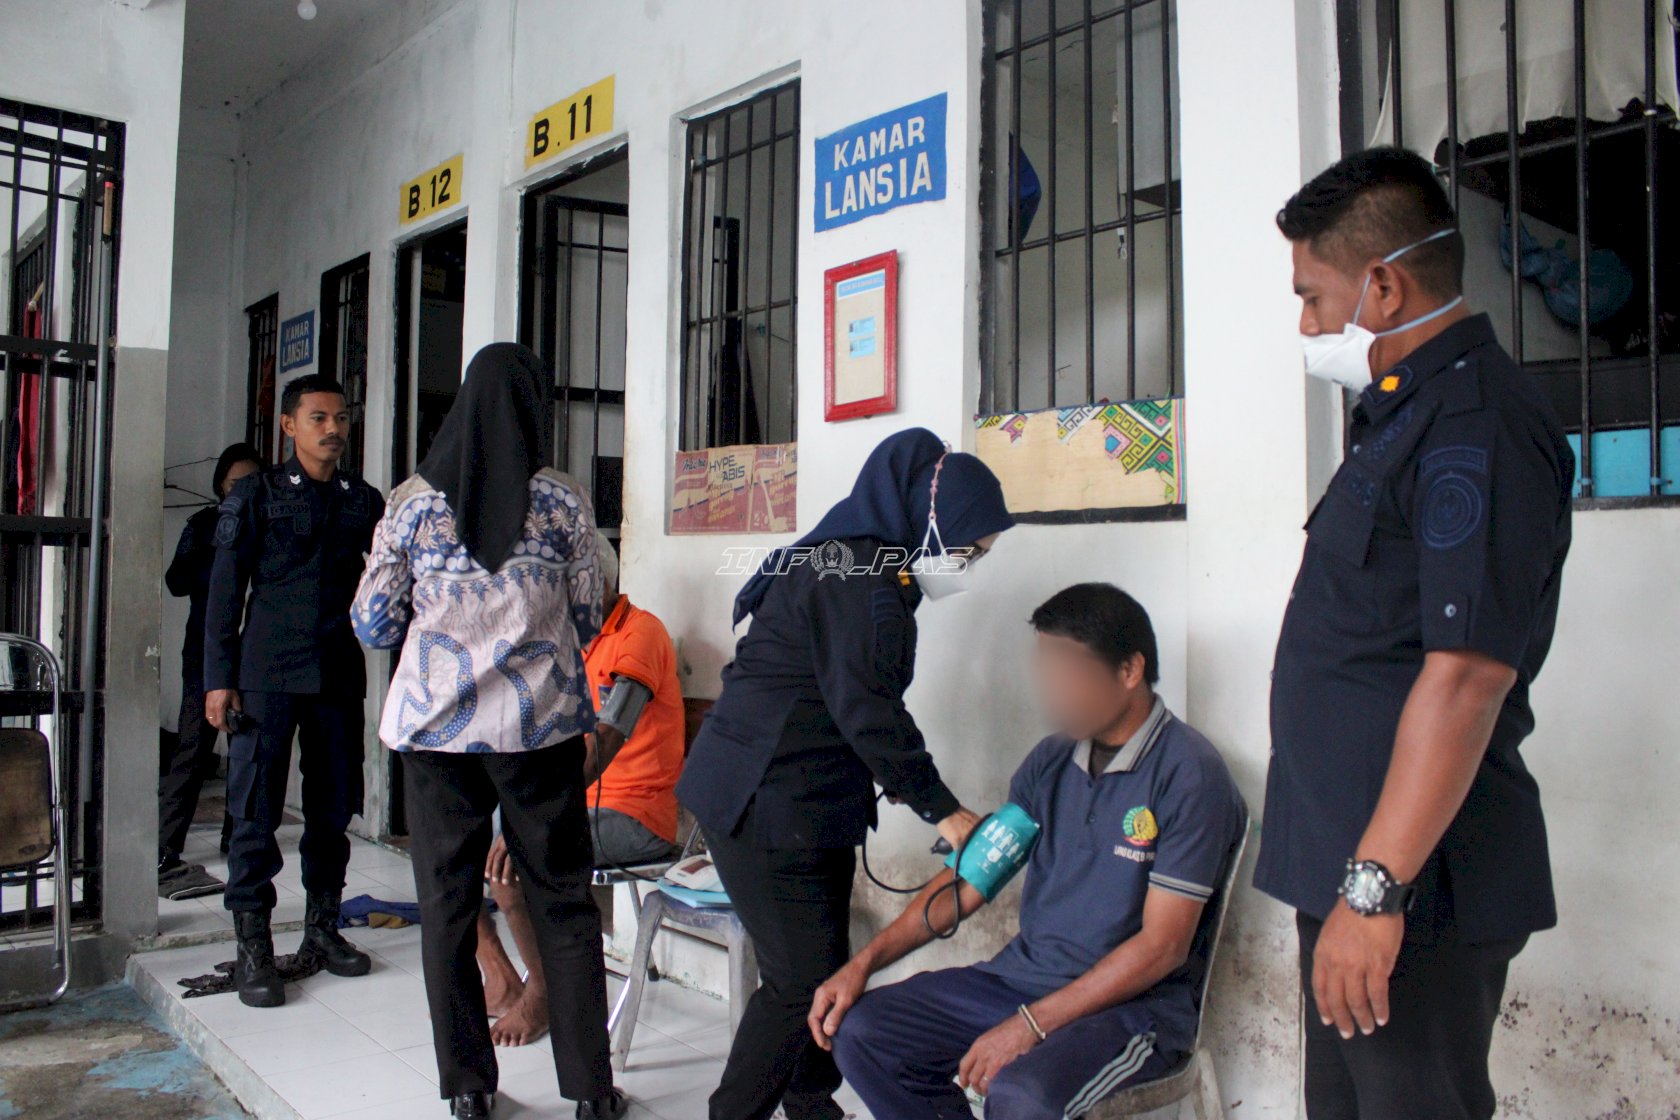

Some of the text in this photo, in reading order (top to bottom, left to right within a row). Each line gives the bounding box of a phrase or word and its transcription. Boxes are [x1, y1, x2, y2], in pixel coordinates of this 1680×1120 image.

[834, 115, 925, 171] KAMAR
[824, 151, 932, 220] LANSIA
[285, 320, 309, 342] KAMAR
[282, 338, 310, 367] LANSIA
[709, 454, 737, 473] HYPE
[721, 465, 745, 483] ABIS
